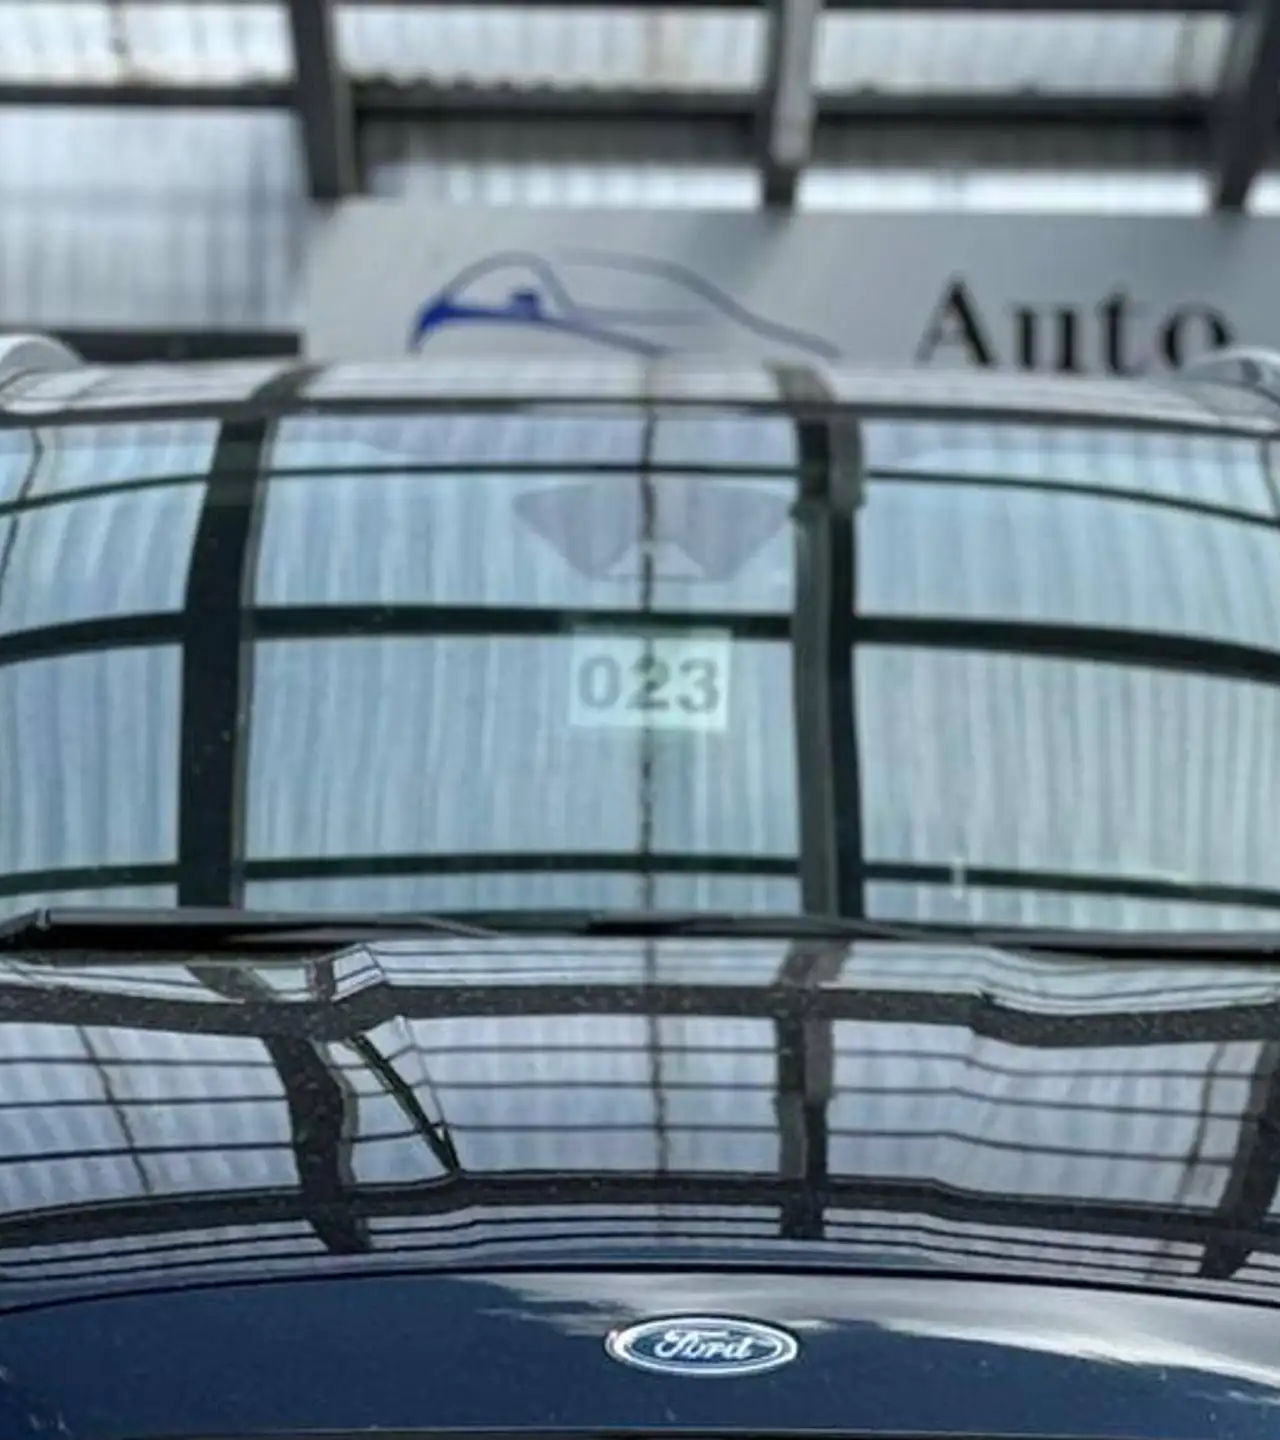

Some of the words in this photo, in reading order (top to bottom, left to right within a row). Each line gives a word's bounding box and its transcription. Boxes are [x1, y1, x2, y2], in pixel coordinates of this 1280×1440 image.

[916, 276, 1236, 374] Auto
[578, 655, 721, 715] 023
[652, 1329, 754, 1361] Ford
